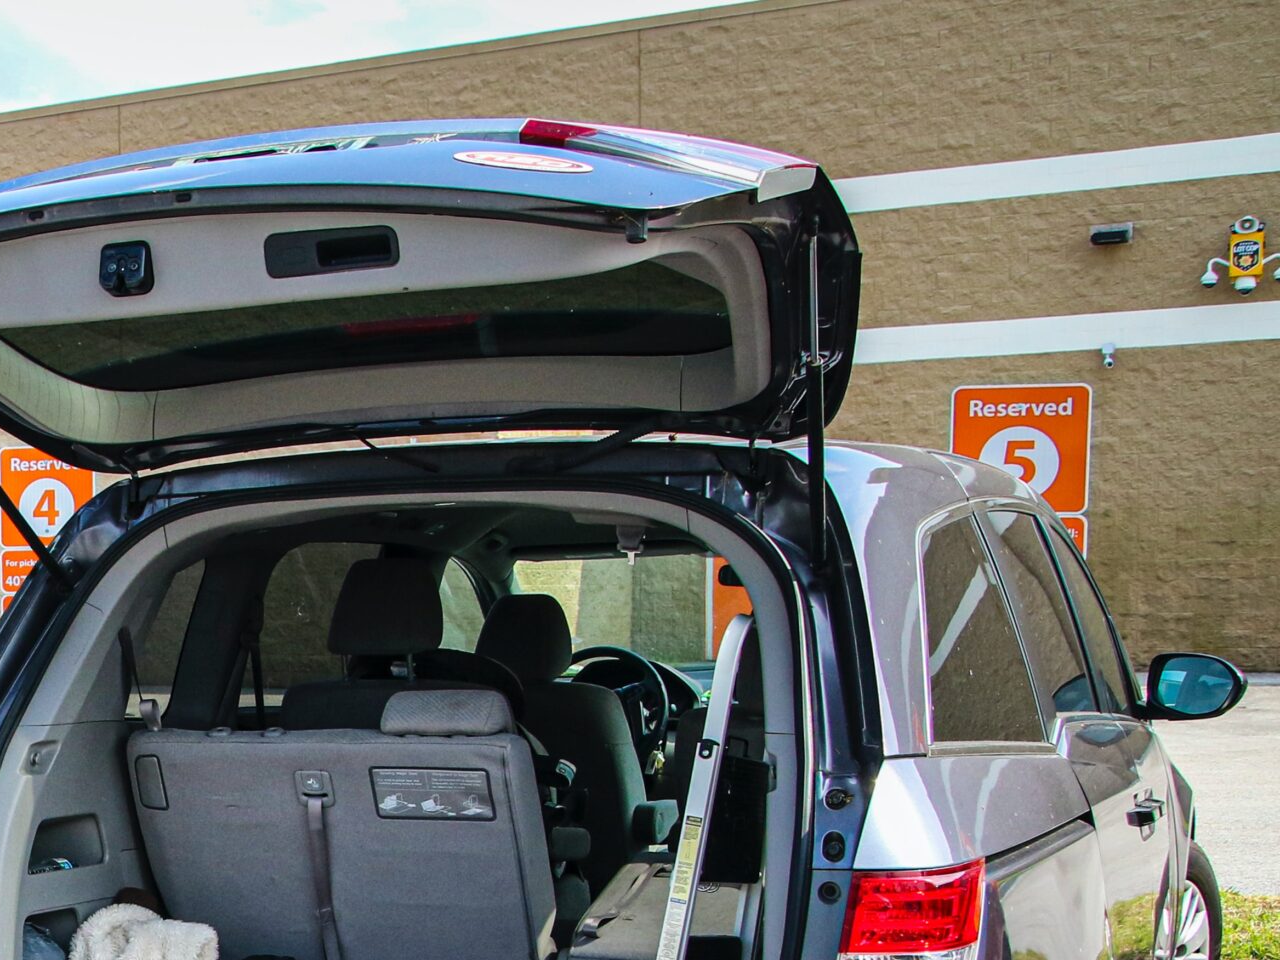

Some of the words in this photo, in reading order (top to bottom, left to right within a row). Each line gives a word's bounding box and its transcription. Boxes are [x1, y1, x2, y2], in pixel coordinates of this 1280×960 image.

[969, 397, 1073, 418] Reserved
[10, 457, 79, 472] Reserve
[1003, 440, 1036, 484] 5
[32, 489, 60, 527] 4
[5, 559, 18, 567] For
[19, 559, 37, 568] pick
